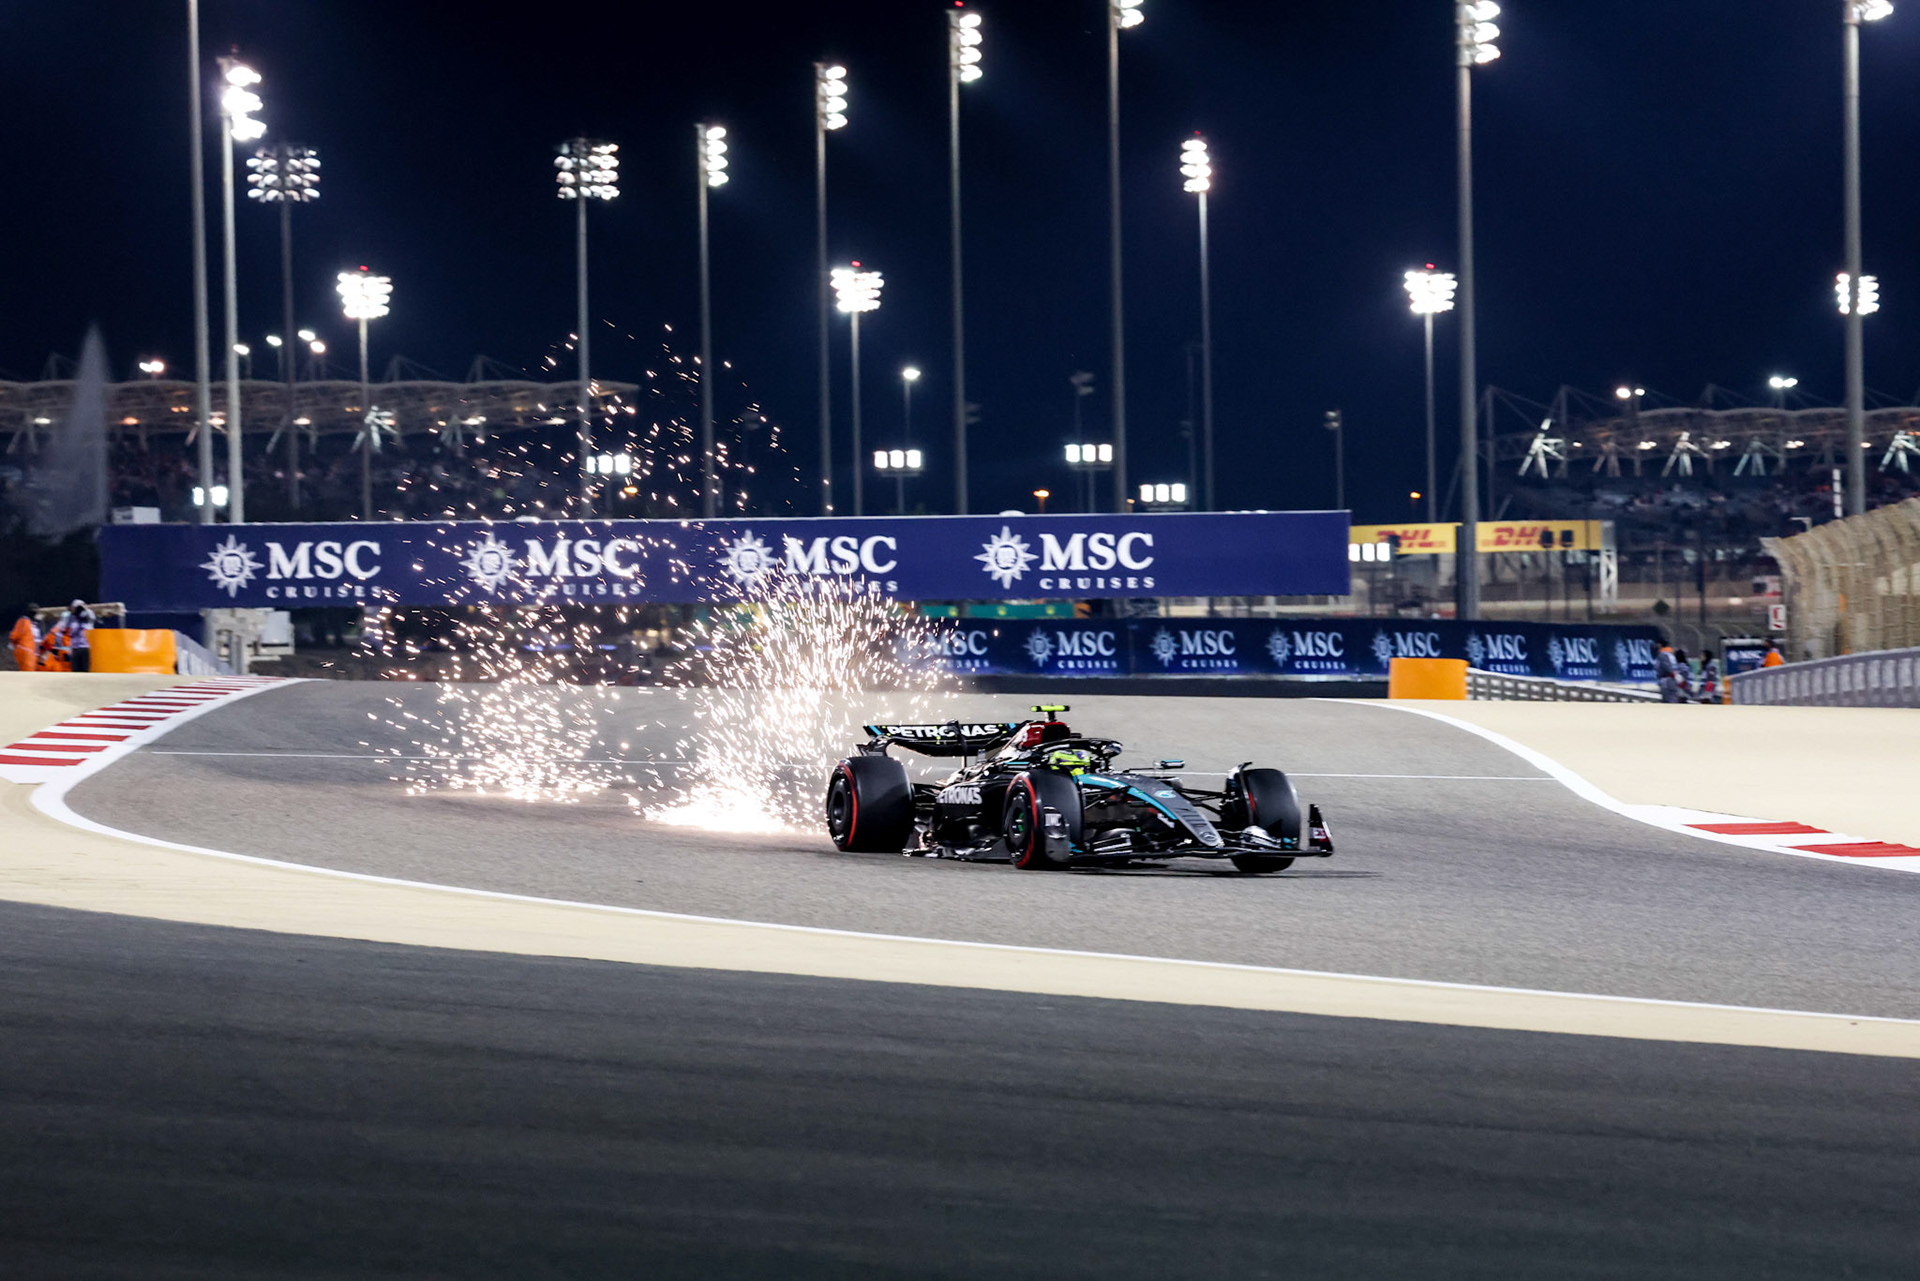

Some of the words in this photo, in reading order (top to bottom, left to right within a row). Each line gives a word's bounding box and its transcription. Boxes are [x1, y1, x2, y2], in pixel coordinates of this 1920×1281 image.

[1494, 526, 1549, 546] DH
[264, 541, 381, 580] MSC
[523, 539, 640, 578] MSC
[784, 536, 898, 575] MSC
[1038, 532, 1154, 571] MSC
[265, 585, 382, 599] CRUISES
[523, 583, 641, 597] CRUISES
[780, 580, 899, 594] CRISES
[1039, 576, 1155, 590] CRUISES
[926, 630, 988, 657] MSC
[1057, 631, 1116, 657] MSC
[1179, 630, 1236, 656] MSC
[1293, 631, 1344, 658] MSC
[1394, 632, 1441, 657] MSC
[1485, 634, 1528, 660] MSC
[1563, 637, 1599, 663] MSC
[1057, 660, 1118, 669] CRUISES
[1181, 659, 1238, 668] CRUISES
[1294, 661, 1347, 669] CRUISES
[887, 725, 1000, 738] PETRONAS
